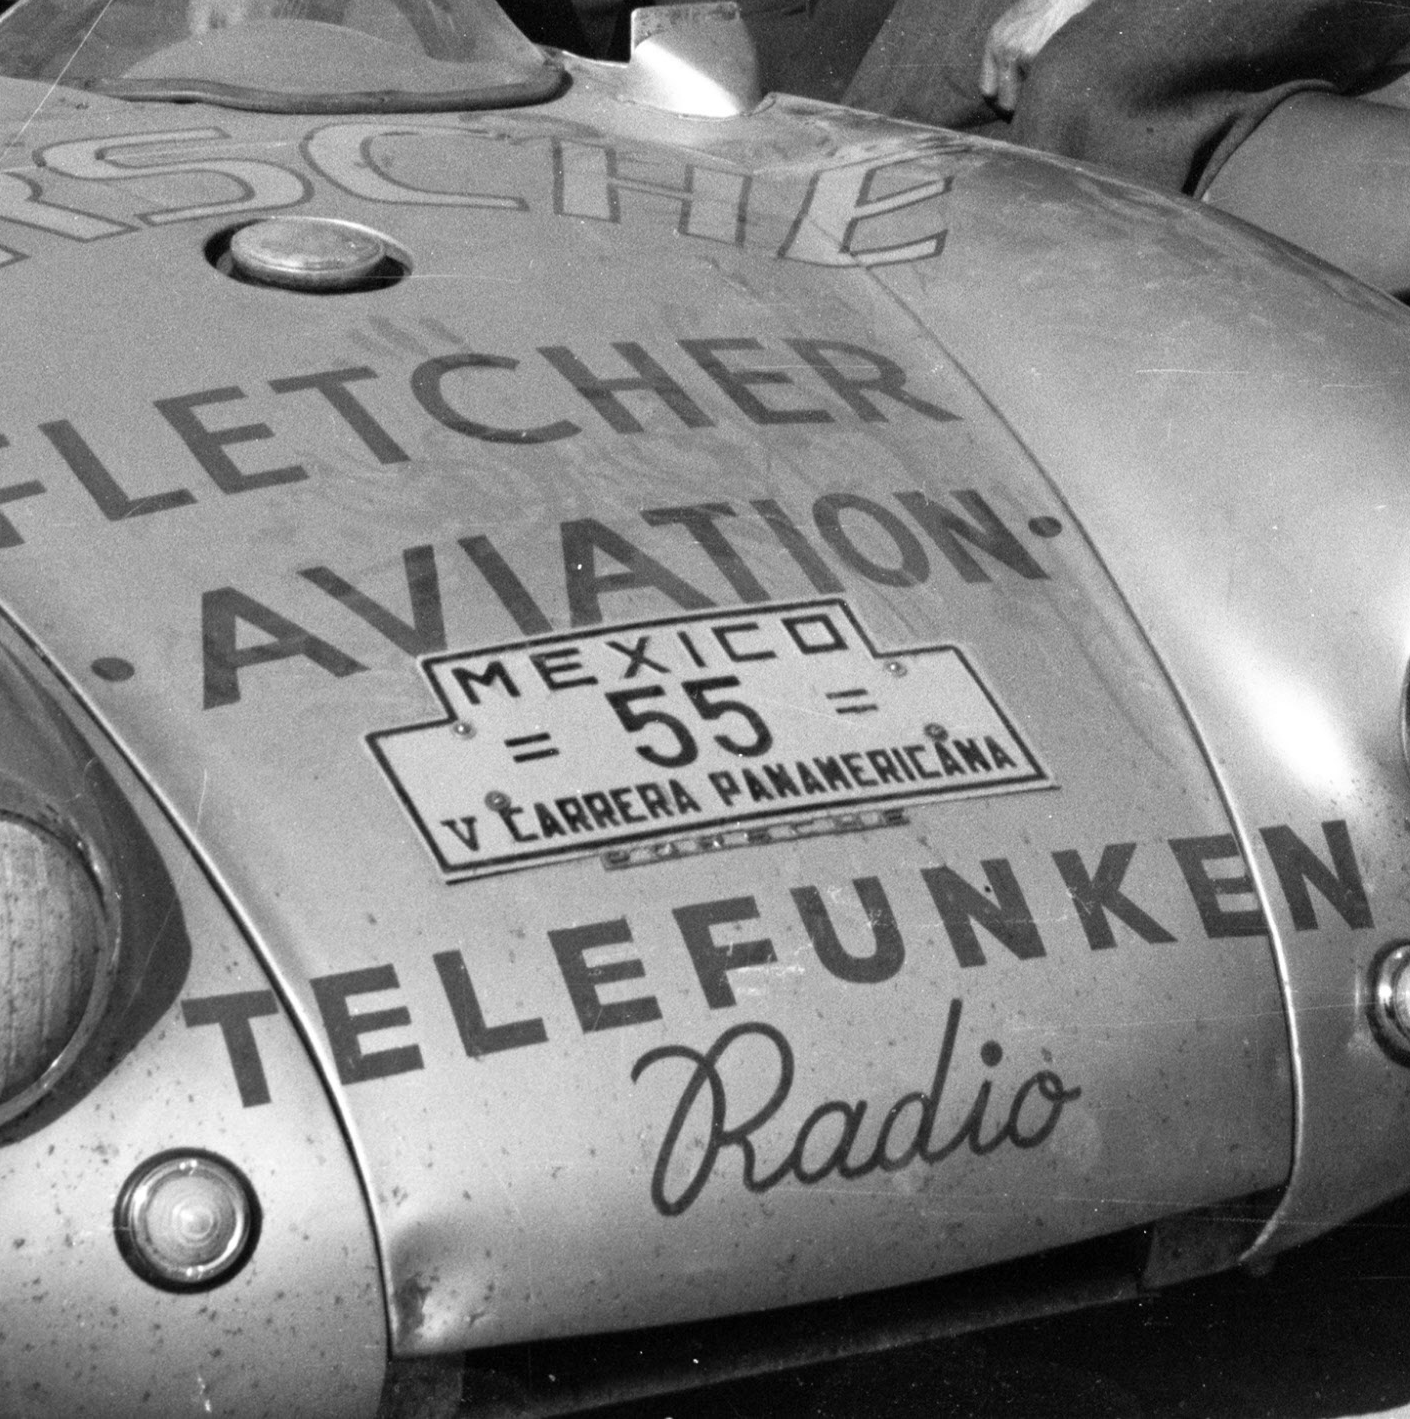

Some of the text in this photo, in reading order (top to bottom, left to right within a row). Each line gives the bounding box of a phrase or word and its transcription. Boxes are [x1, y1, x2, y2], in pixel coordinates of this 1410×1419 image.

[201, 487, 1057, 708] AVIATION
[451, 614, 849, 706] MEXICO
[441, 817, 481, 852] V
[504, 777, 703, 845] CARRERA
[708, 733, 1019, 806] PANAMERICANA
[604, 674, 774, 769] 55
[183, 819, 1375, 1109] TELEFUNKEN
[631, 997, 1082, 1217] Radio
